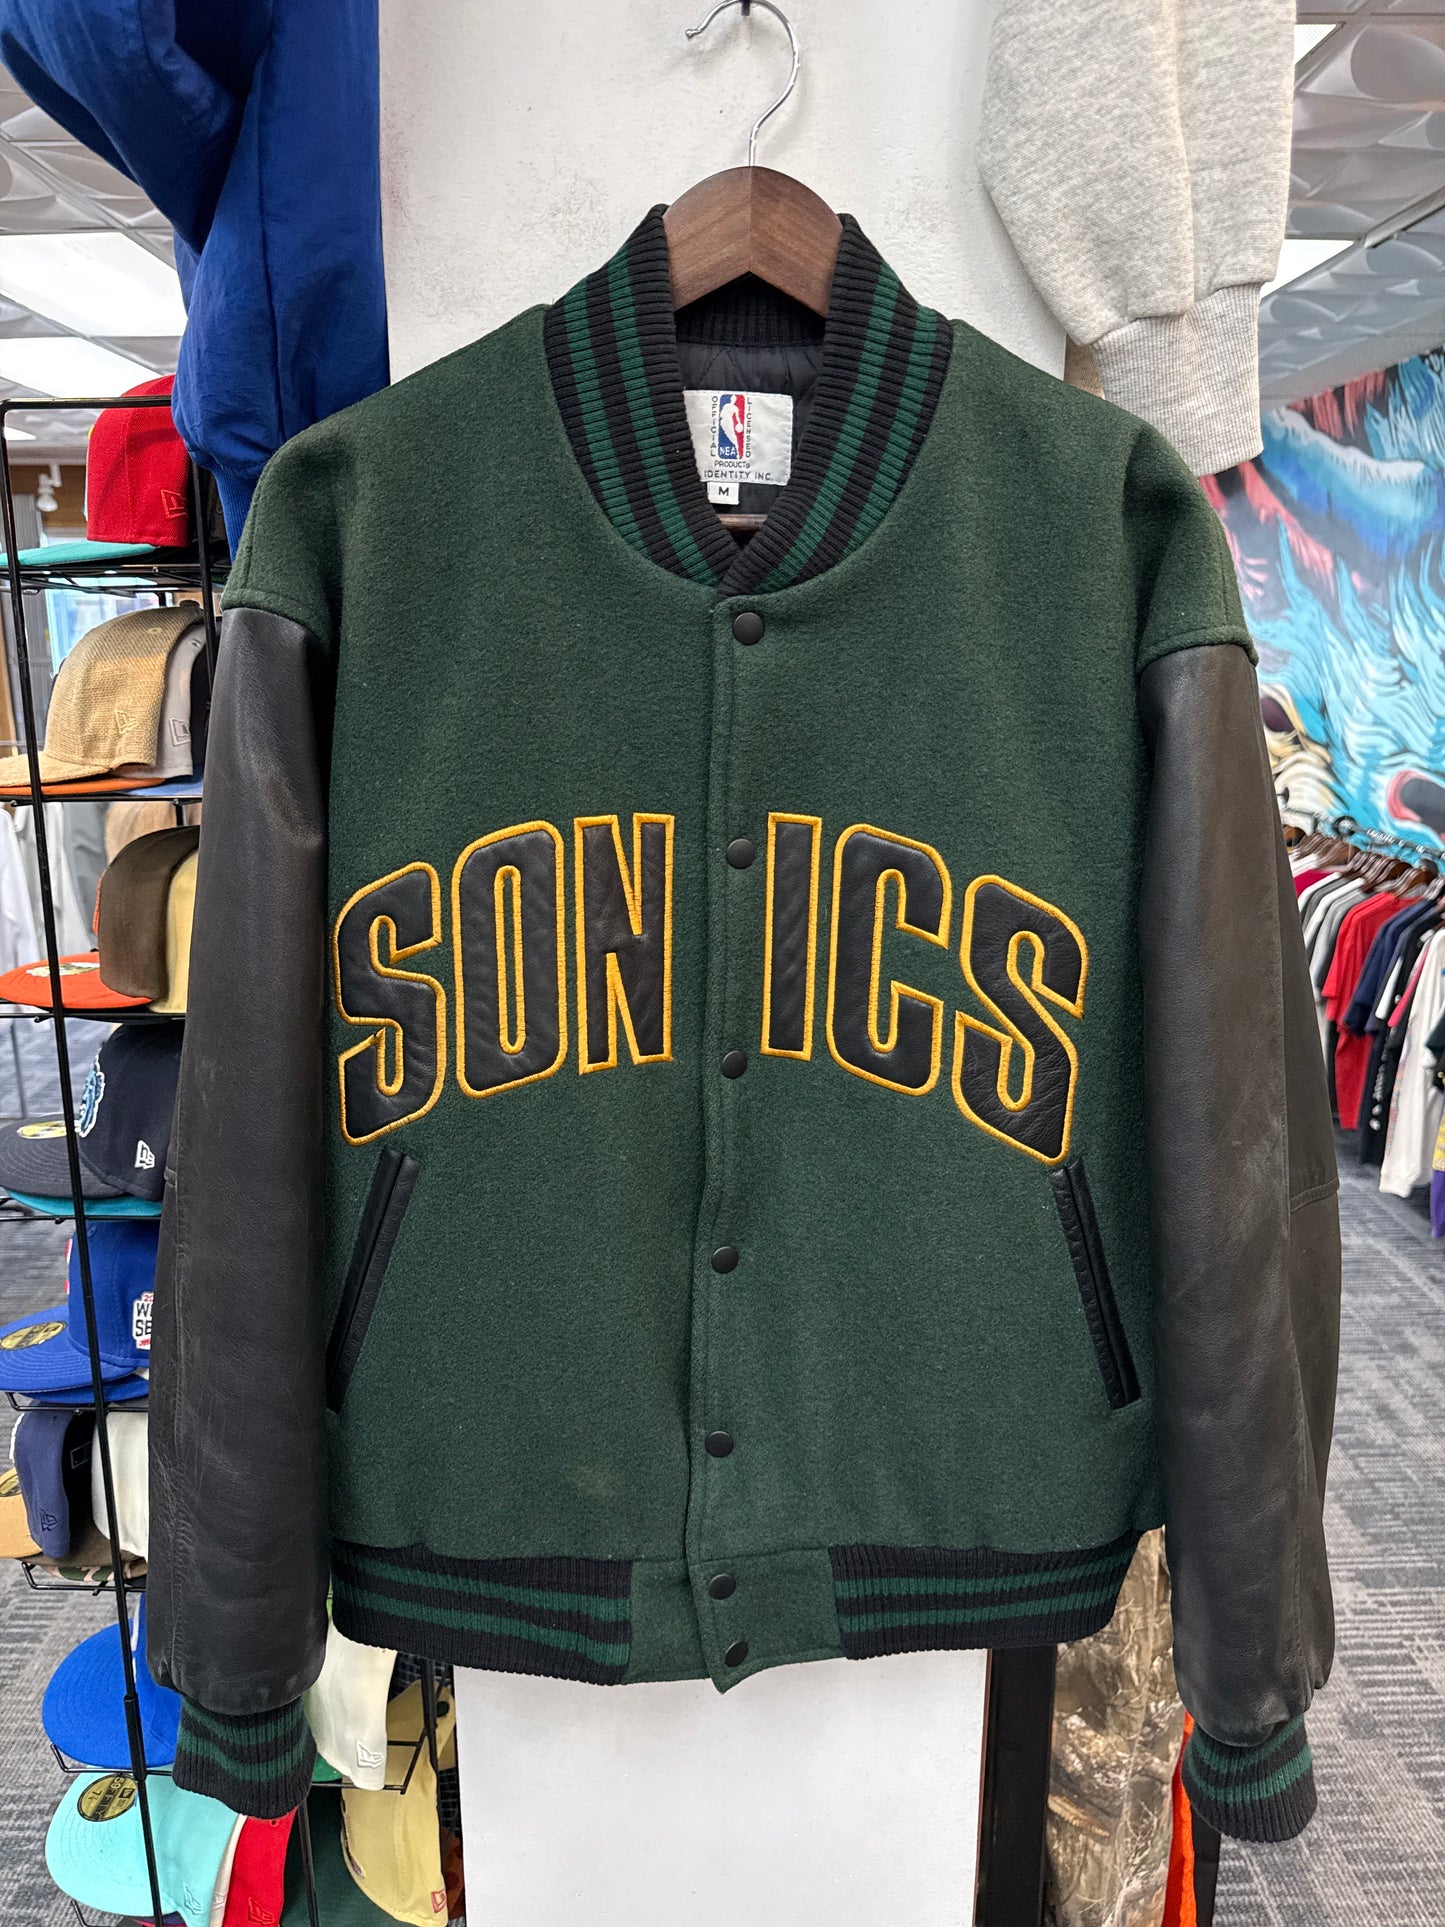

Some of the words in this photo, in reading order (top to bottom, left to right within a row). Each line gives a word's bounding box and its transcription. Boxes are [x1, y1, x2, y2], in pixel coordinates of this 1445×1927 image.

[710, 396, 718, 457] OFFICIAL
[704, 470, 751, 479] IDENTITY
[755, 472, 773, 481] INC.
[718, 486, 729, 497] M
